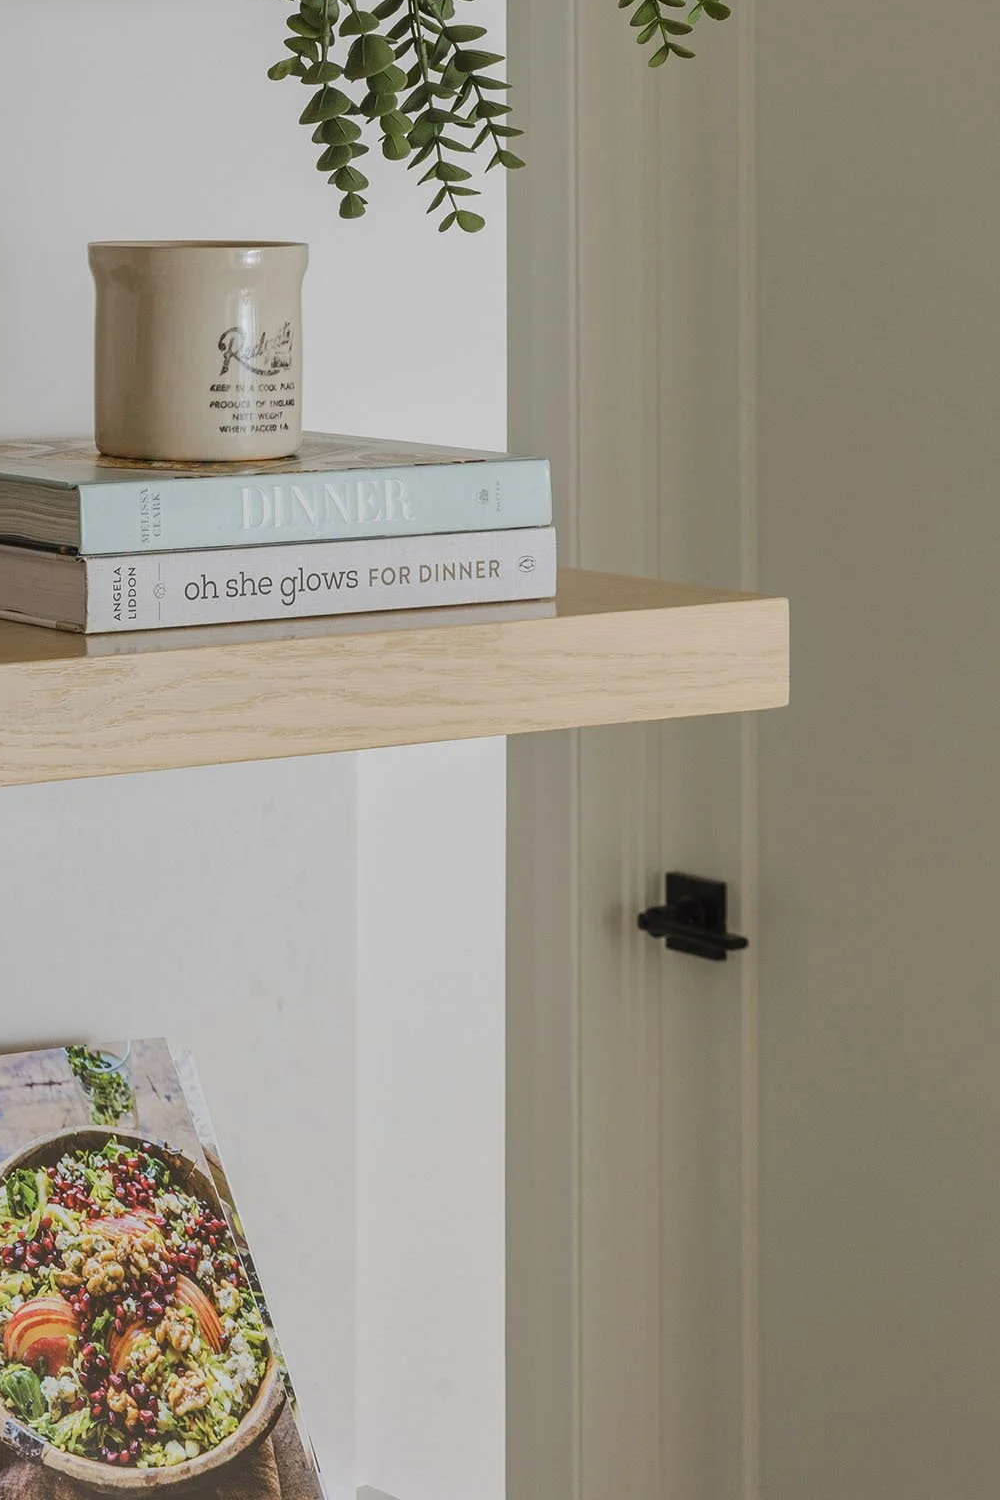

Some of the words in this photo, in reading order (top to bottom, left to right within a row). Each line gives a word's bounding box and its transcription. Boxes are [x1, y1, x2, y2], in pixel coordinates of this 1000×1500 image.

[209, 400, 251, 409] PRODUCE
[256, 400, 265, 408] OF
[210, 384, 231, 392] KEEP
[236, 384, 245, 392] IN
[220, 425, 246, 433] WHEN
[251, 423, 277, 432] PACKED
[140, 488, 150, 544] MELISSA
[153, 492, 161, 538] CLARK
[239, 479, 415, 530] DINNER
[113, 566, 122, 622] ANGELA
[128, 567, 137, 620] LIDDON
[184, 574, 219, 601] oh
[226, 571, 273, 597] she
[279, 566, 359, 605] glows
[369, 565, 410, 587] FOR
[419, 559, 500, 584] DINNER
